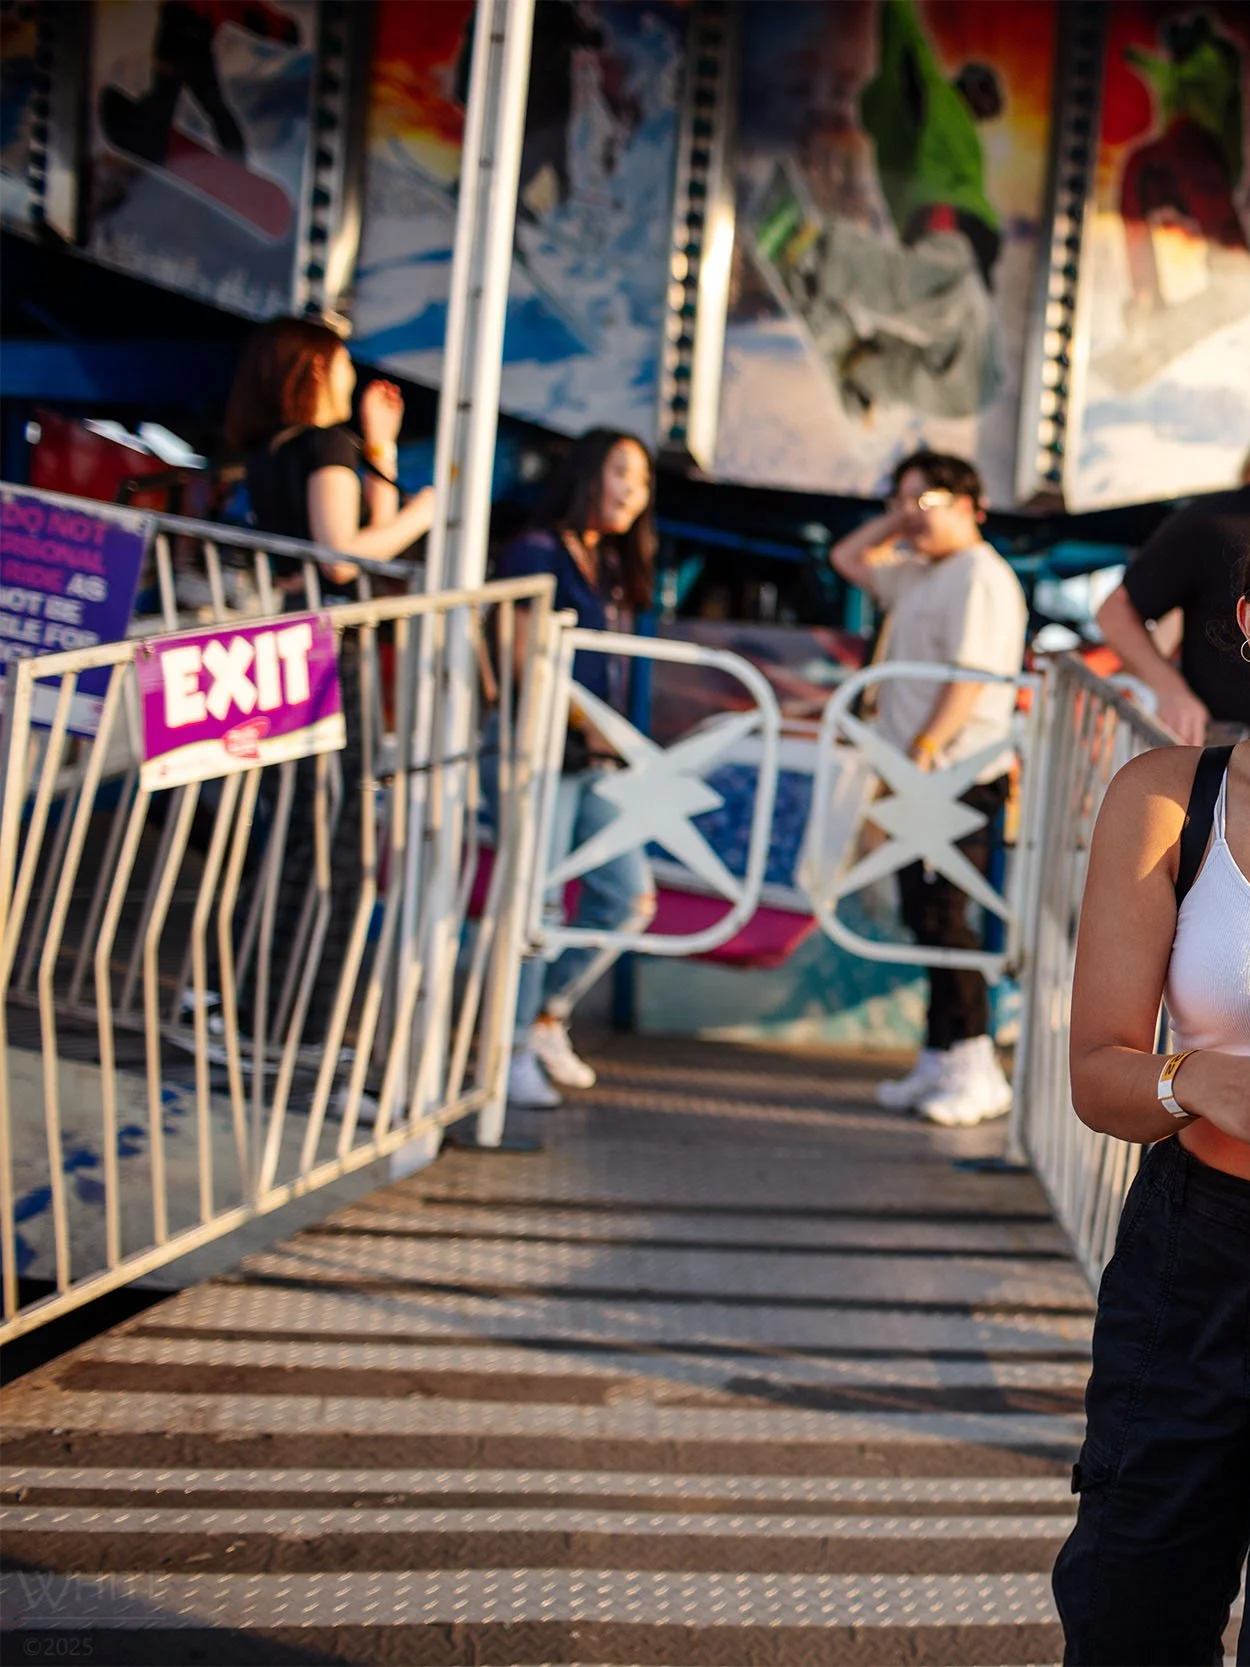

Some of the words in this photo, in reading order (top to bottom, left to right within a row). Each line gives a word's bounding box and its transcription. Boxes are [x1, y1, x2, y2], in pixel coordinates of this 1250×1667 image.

[47, 511, 109, 546] NOT
[66, 572, 109, 602] AS
[161, 623, 313, 728] EXIT
